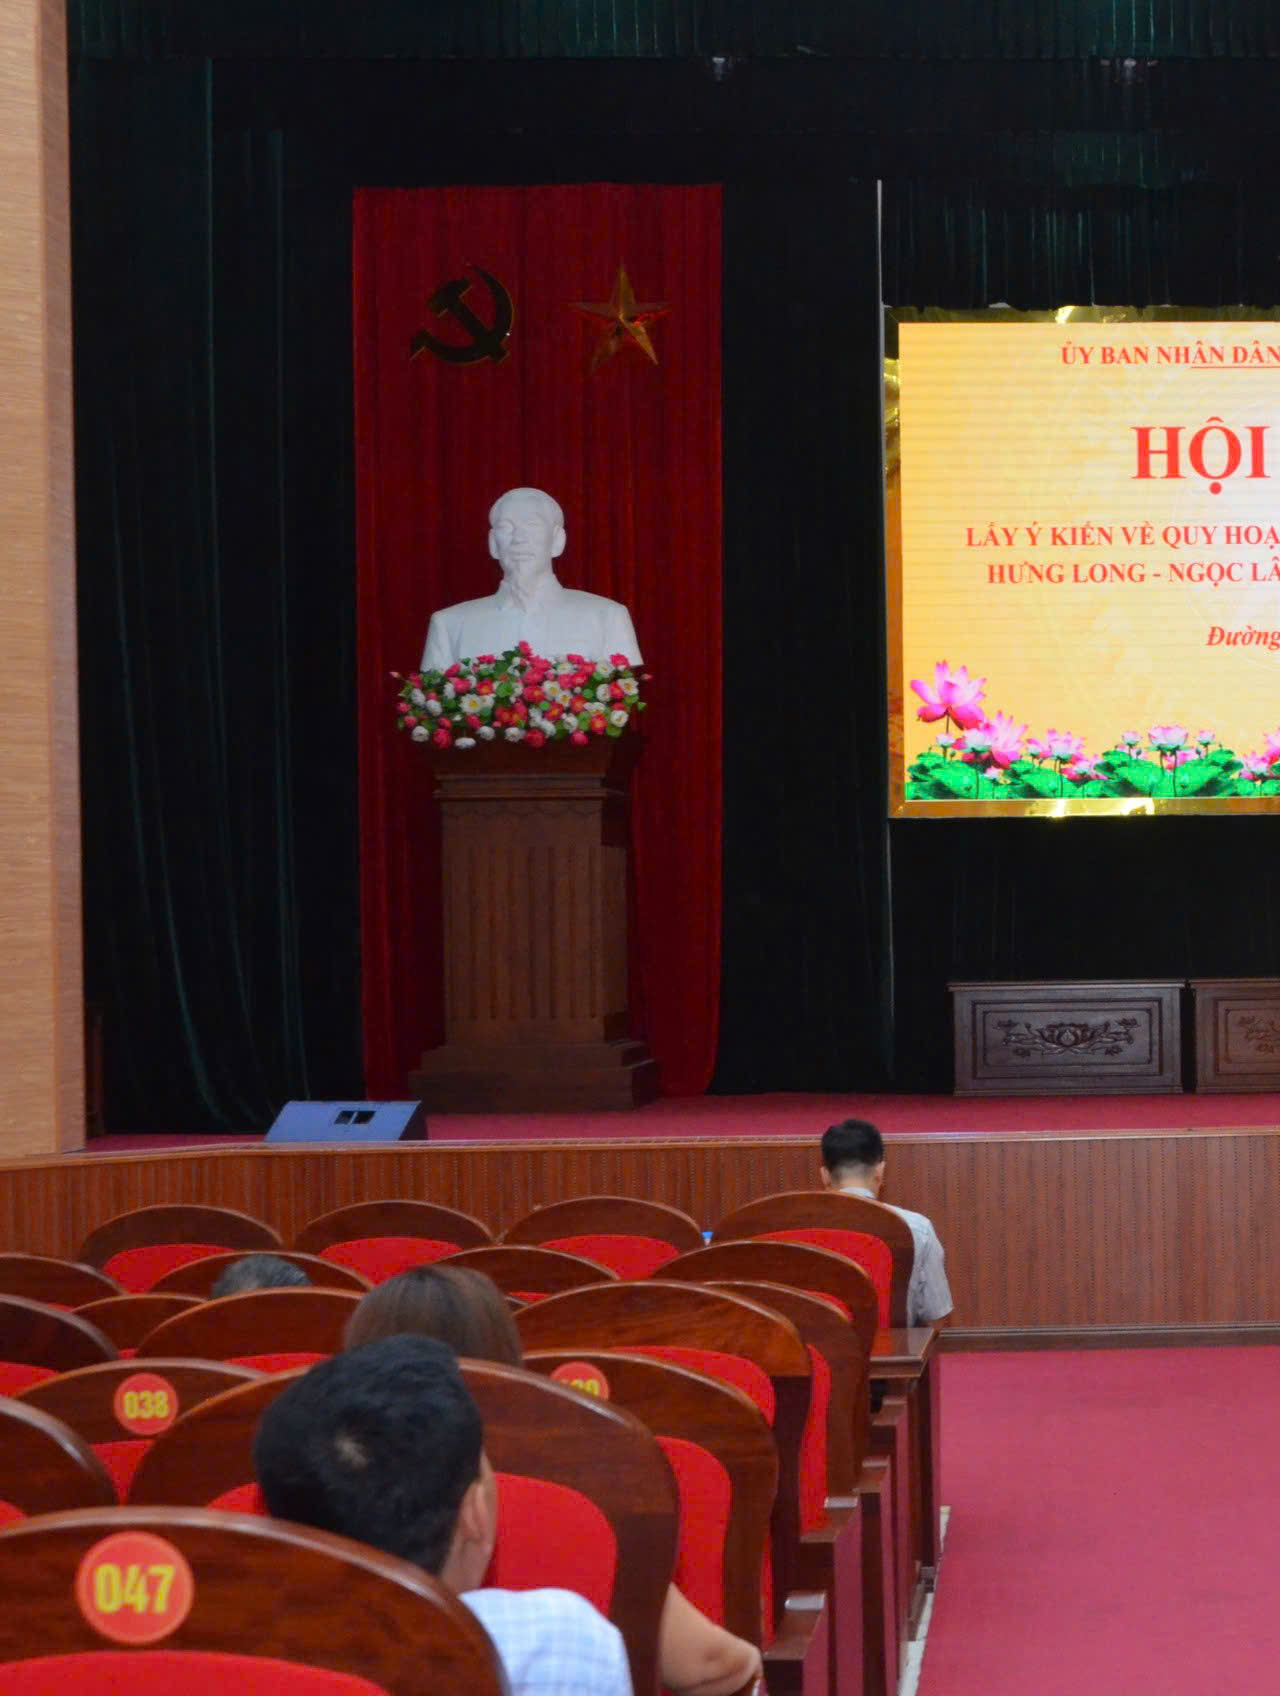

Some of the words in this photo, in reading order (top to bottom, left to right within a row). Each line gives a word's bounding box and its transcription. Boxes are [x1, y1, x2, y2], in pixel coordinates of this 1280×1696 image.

[1061, 340, 1096, 365] ỦY
[1100, 346, 1149, 365] BAN
[1156, 340, 1225, 365] NHÂN
[1232, 340, 1280, 364] DÂN
[1131, 416, 1270, 495] HỘI
[965, 522, 1018, 548] LẤY
[1025, 521, 1042, 547] Ý
[1050, 520, 1113, 547] KIẾN
[1121, 520, 1155, 546] VỀ
[1161, 526, 1217, 550] QUY
[987, 562, 1065, 585] HƯNG
[1072, 562, 1146, 584] LONG
[1168, 562, 1243, 587] NGỌC
[123, 1391, 170, 1418] 038
[95, 1564, 174, 1614] 047
